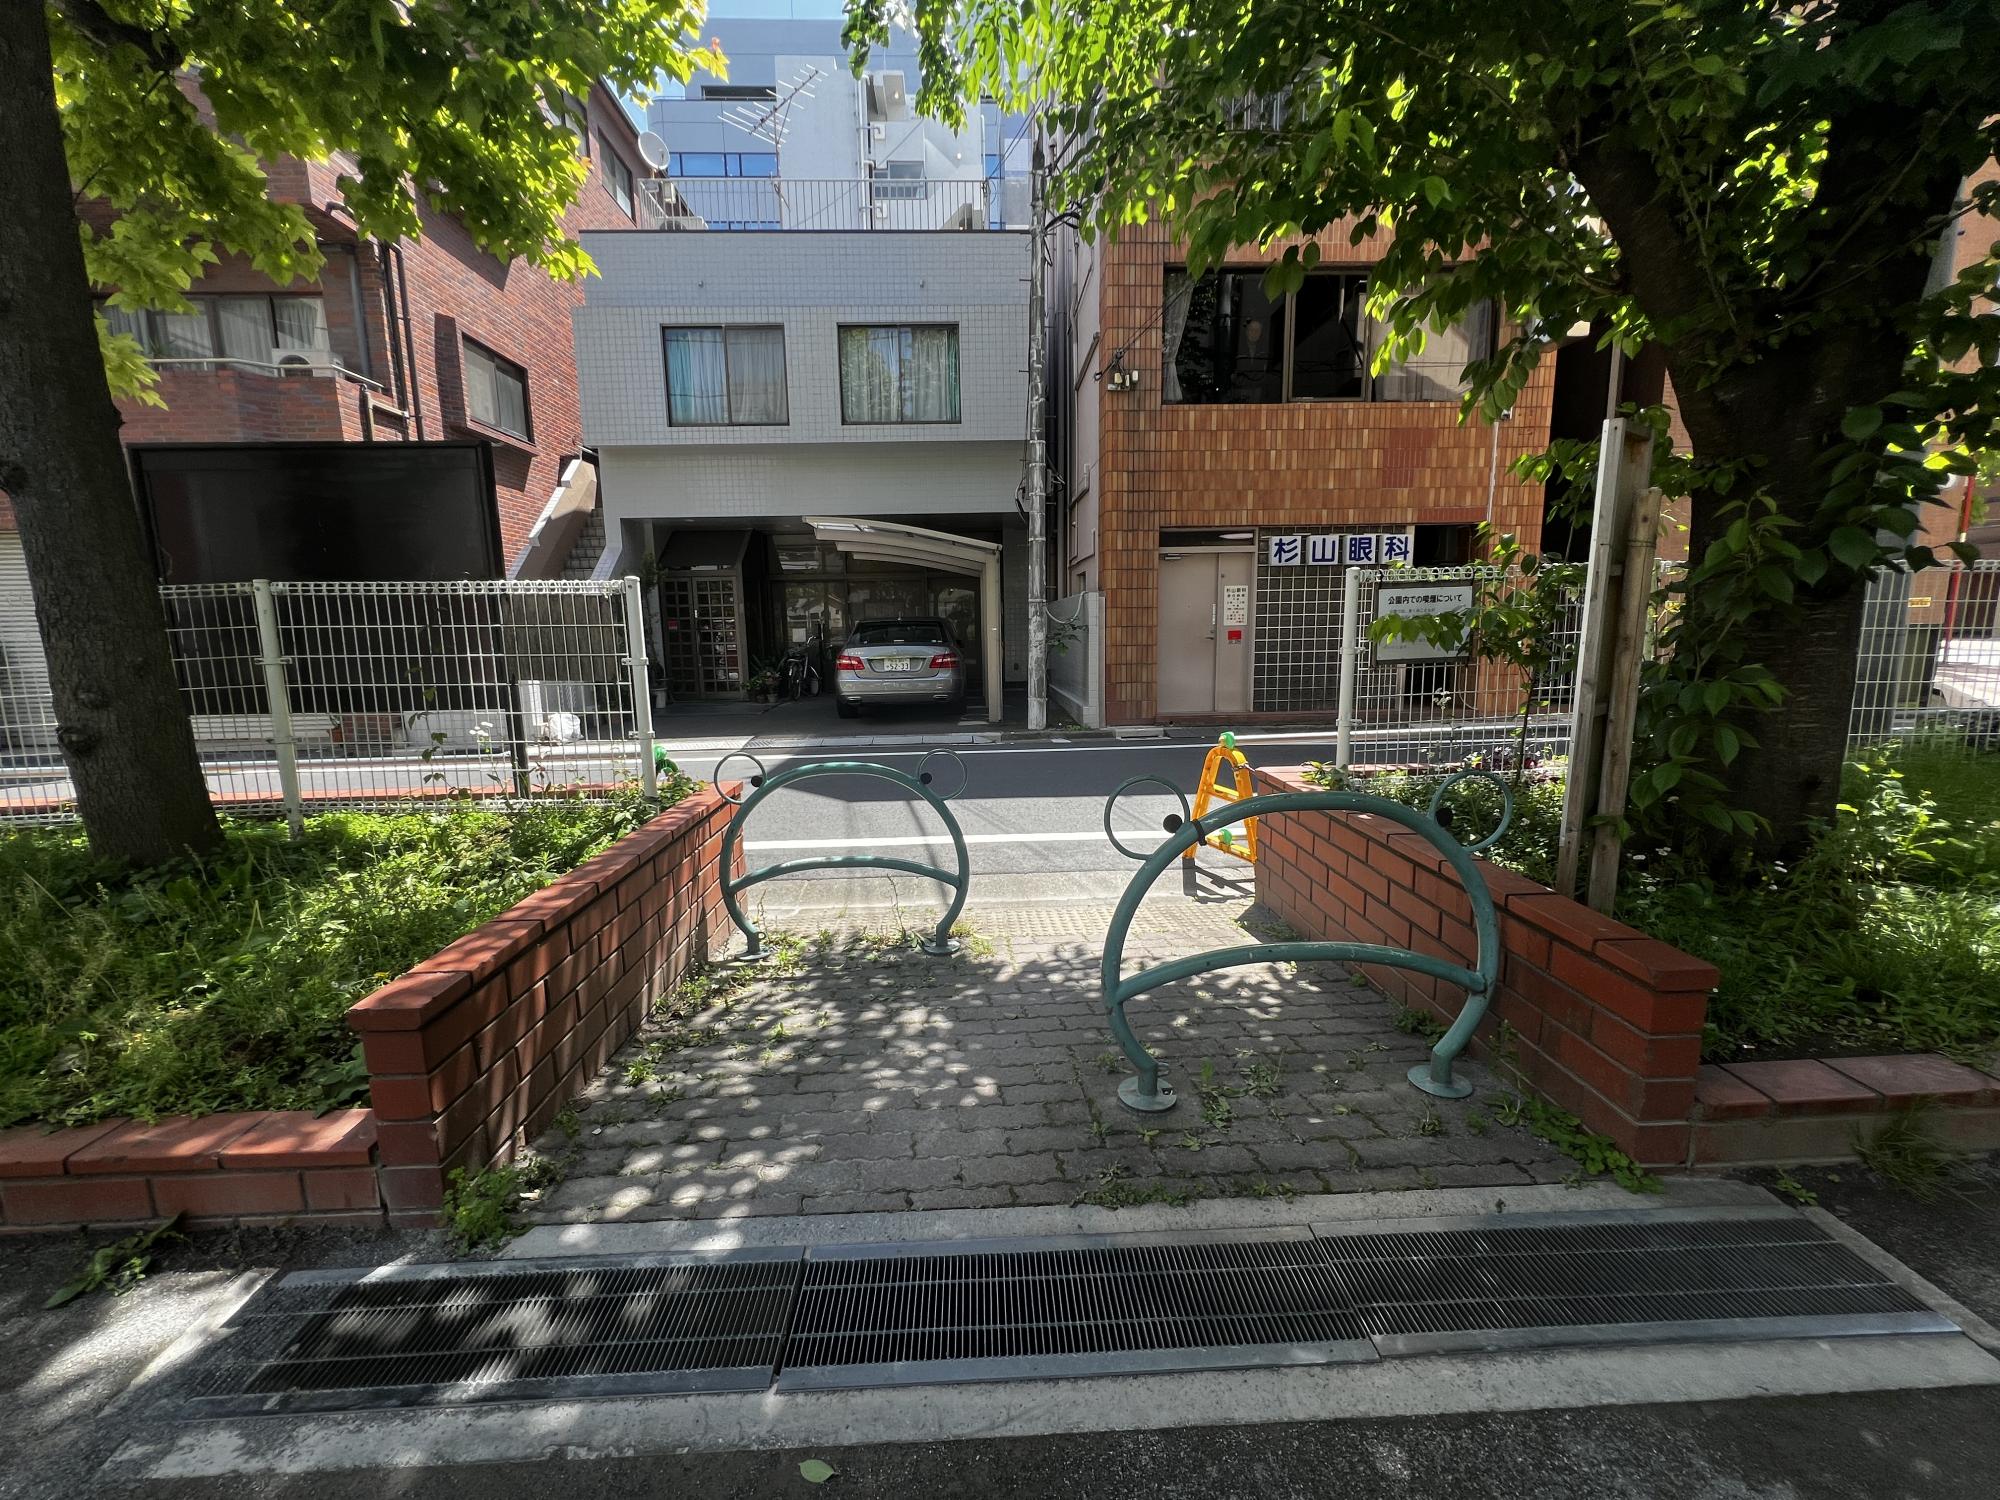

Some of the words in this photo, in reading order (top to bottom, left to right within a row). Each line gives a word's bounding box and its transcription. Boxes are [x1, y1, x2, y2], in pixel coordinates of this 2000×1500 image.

[1274, 536, 1409, 563] 杉山眼科
[1388, 594, 1462, 605] 公園内での喫煙について
